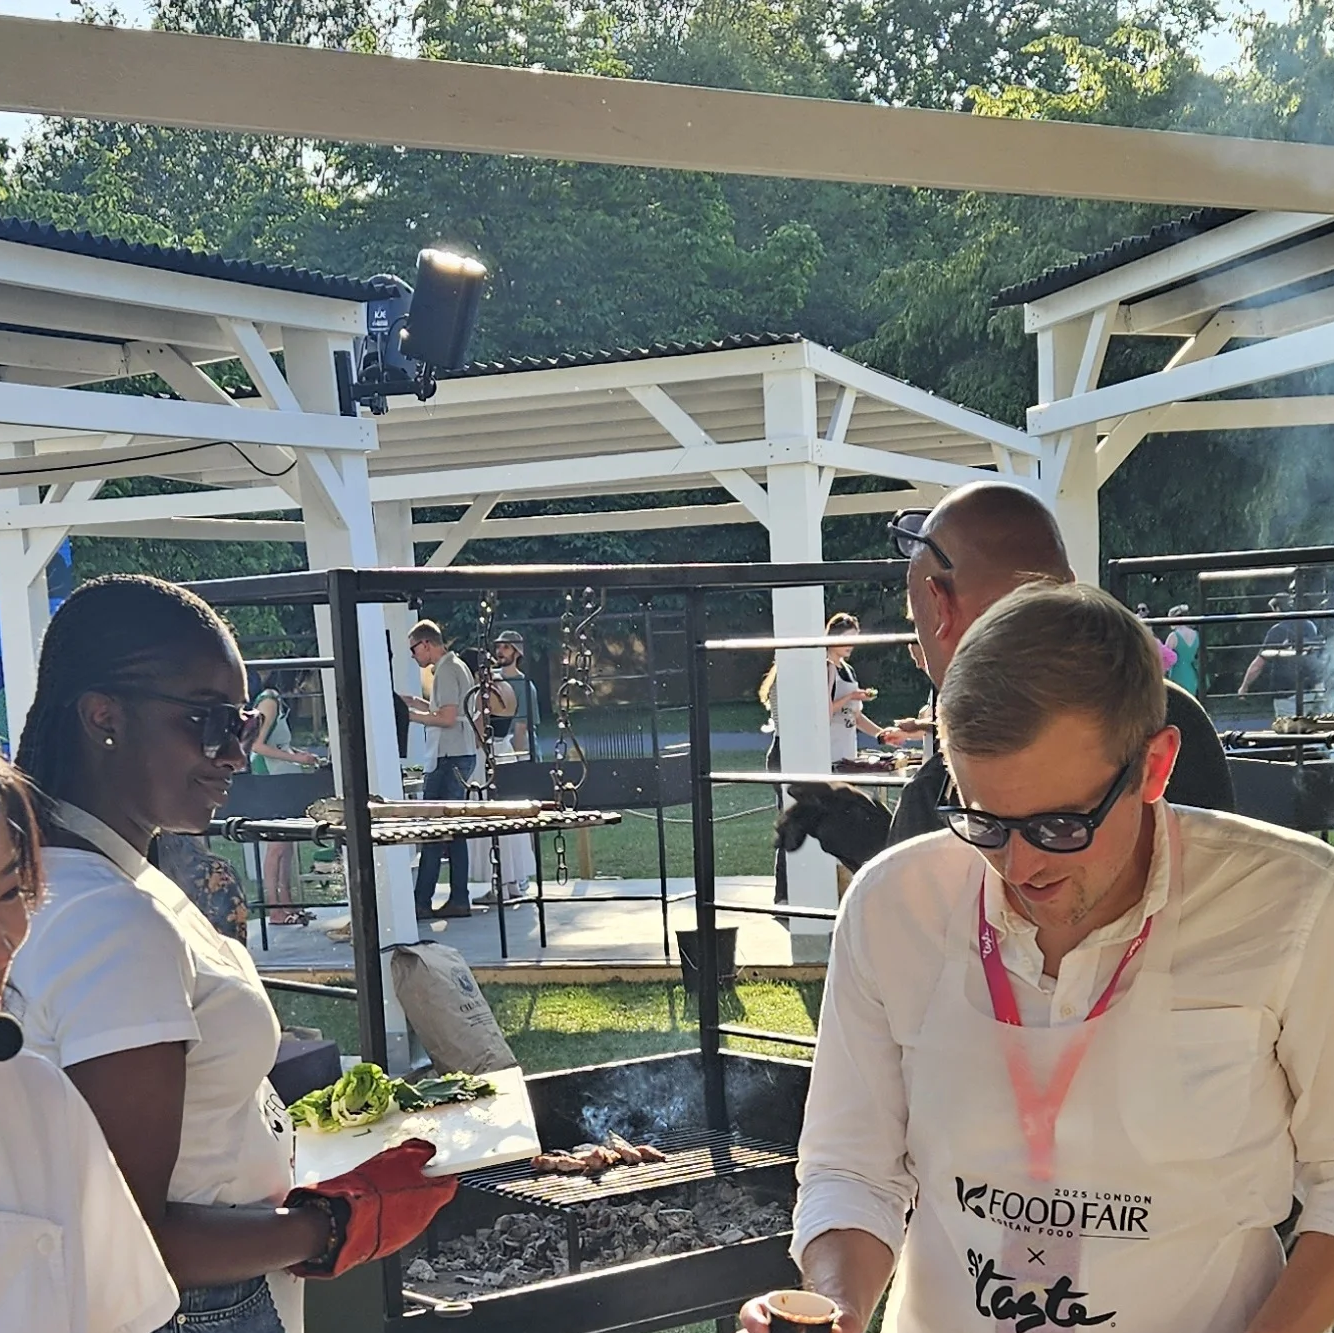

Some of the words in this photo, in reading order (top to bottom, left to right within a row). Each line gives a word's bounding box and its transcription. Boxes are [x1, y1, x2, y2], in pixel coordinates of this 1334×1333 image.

[1054, 1188, 1087, 1199] 2025
[1095, 1192, 1152, 1204] LONDON
[1081, 1202, 1148, 1232] FAIR
[1038, 1227, 1073, 1238] FOOD
